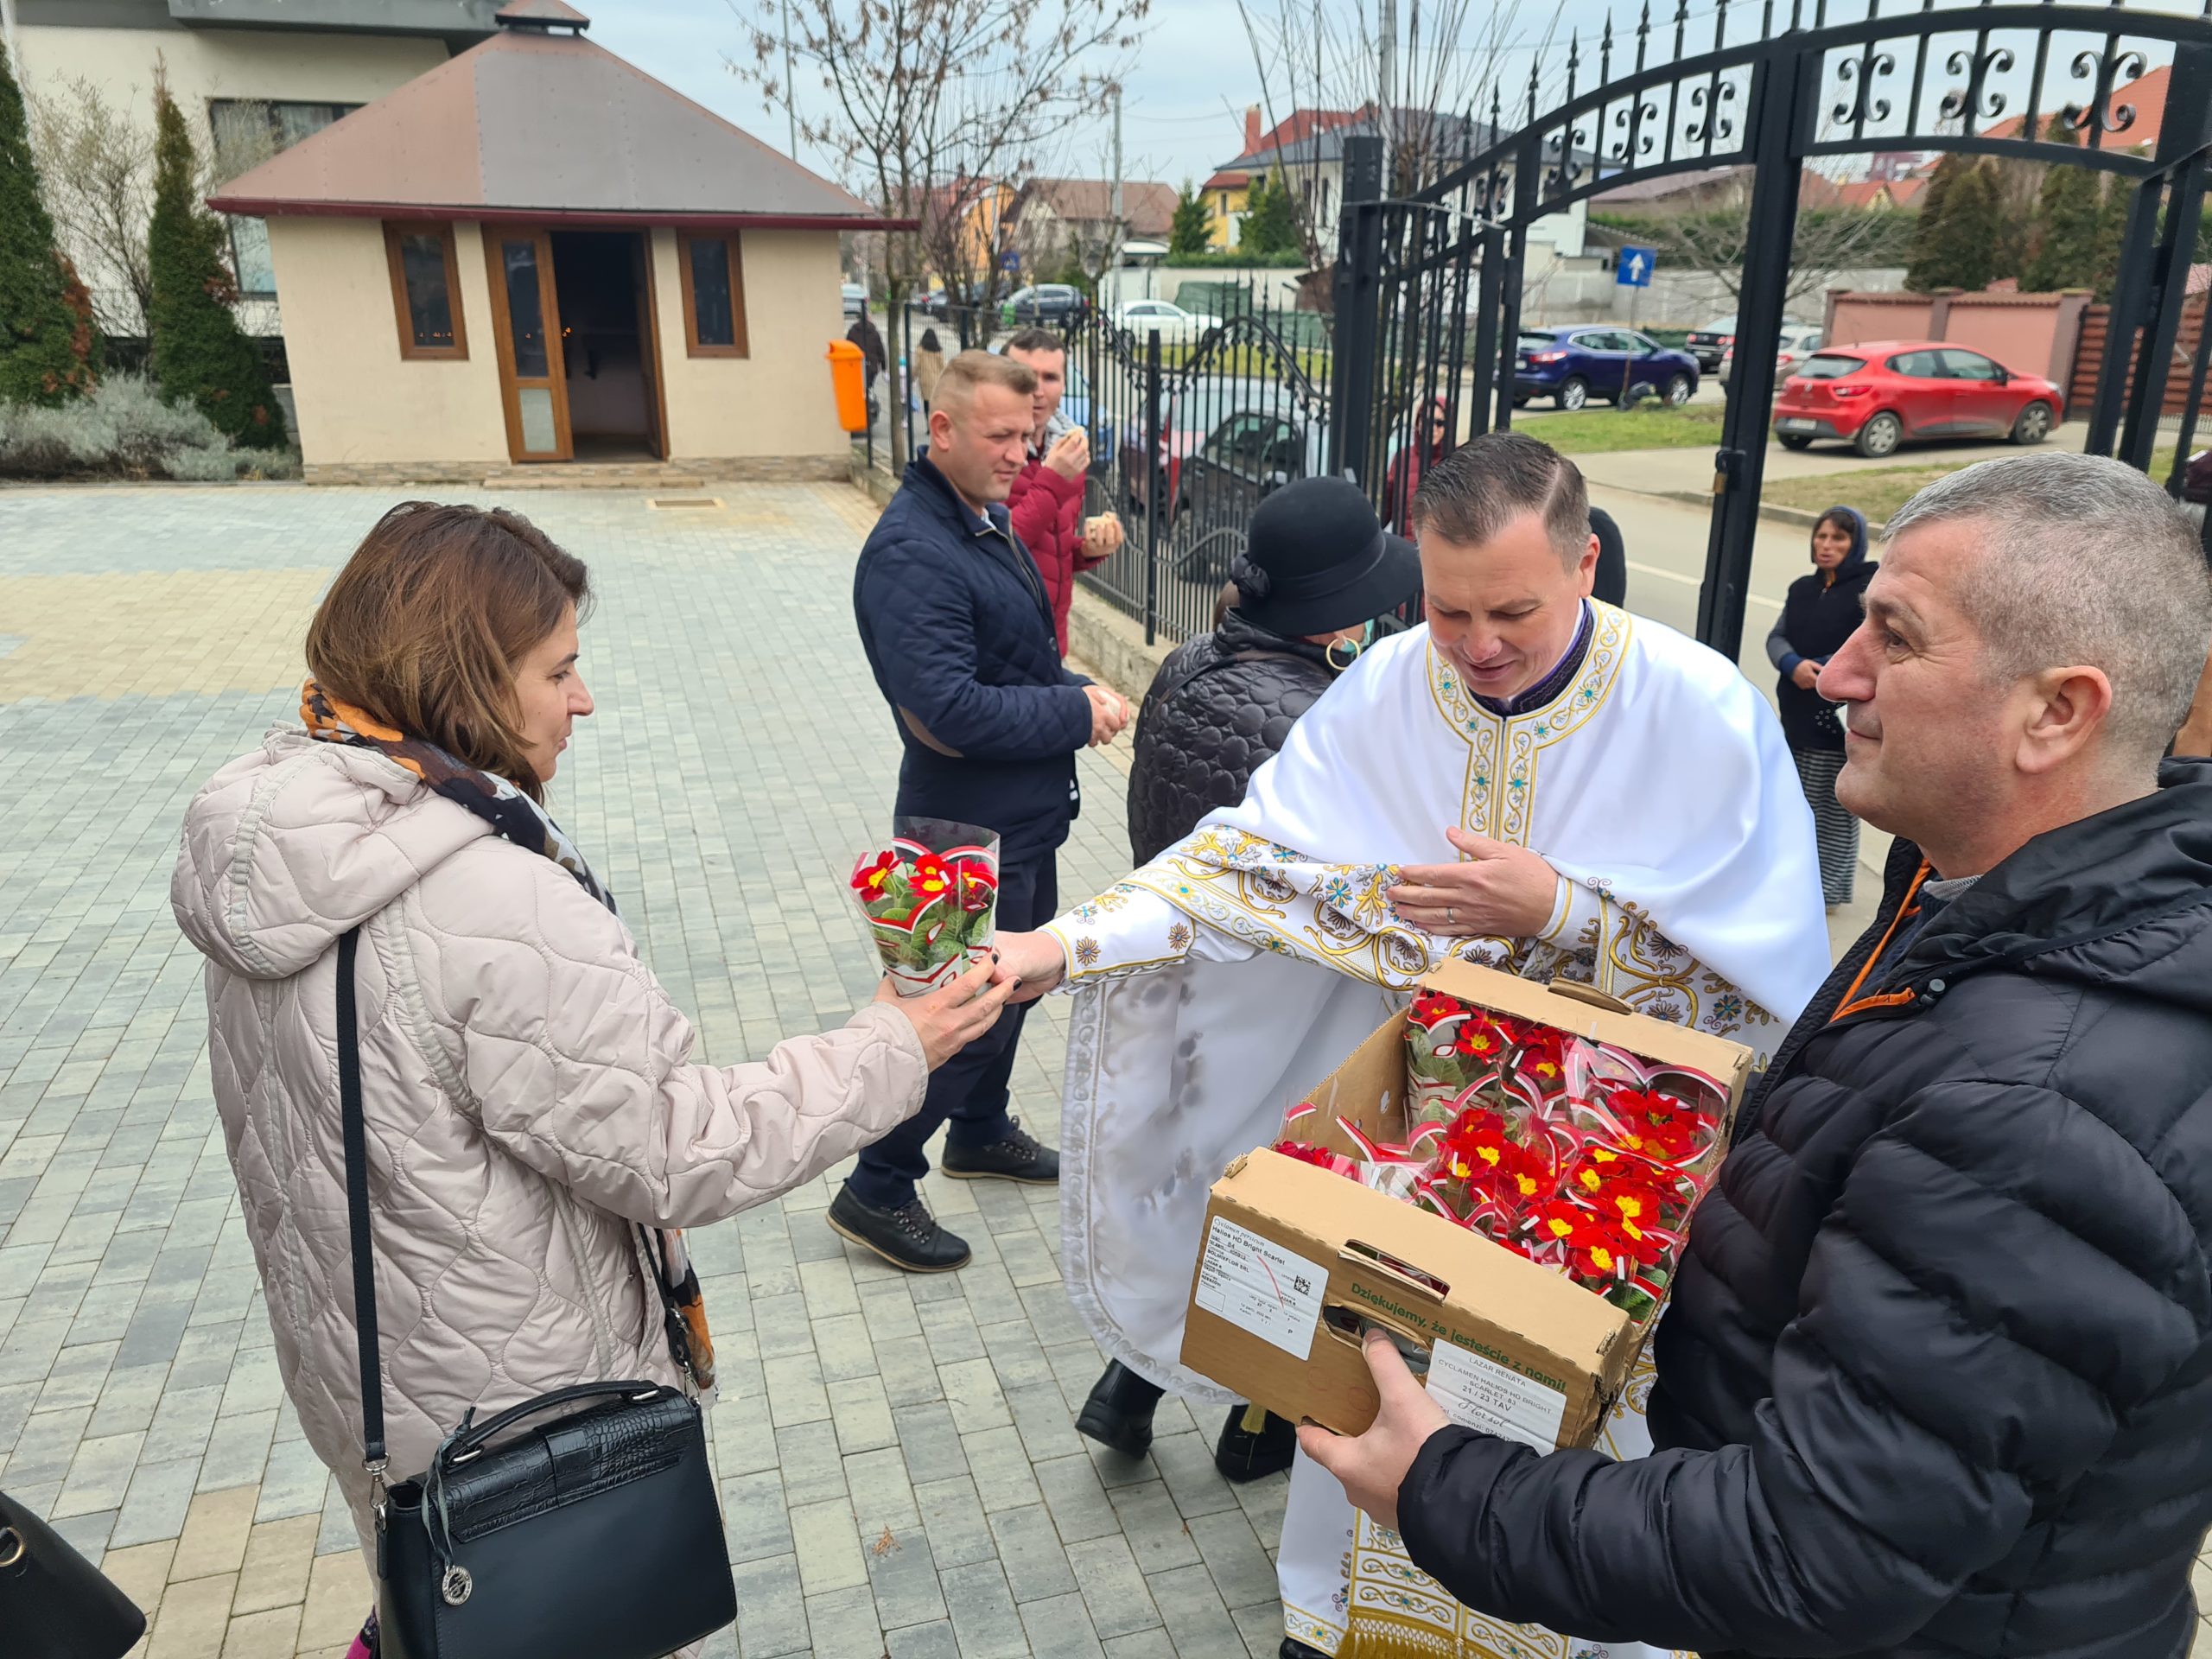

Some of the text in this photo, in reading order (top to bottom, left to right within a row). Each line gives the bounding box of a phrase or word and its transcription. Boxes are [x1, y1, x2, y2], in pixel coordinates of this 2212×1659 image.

[1212, 1225, 1230, 1238] Halios
[1243, 1241, 1262, 1253] Bright
[1263, 1250, 1285, 1265] Scarlet
[1214, 1218, 1239, 1234] Cyclamen
[1239, 1232, 1264, 1247] persicum
[1351, 1282, 1566, 1392] Dziękujemy, że jesteście z nami!
[1438, 1358, 1552, 1414] CYCLAMEN HALIOS HD BRIGHT
[1469, 1357, 1526, 1388] LAZAR RENATA
[1462, 1385, 1471, 1394] 21
[1479, 1393, 1490, 1402] 23
[1493, 1398, 1511, 1412] TAV
[1469, 1380, 1504, 1399] SCARLET
